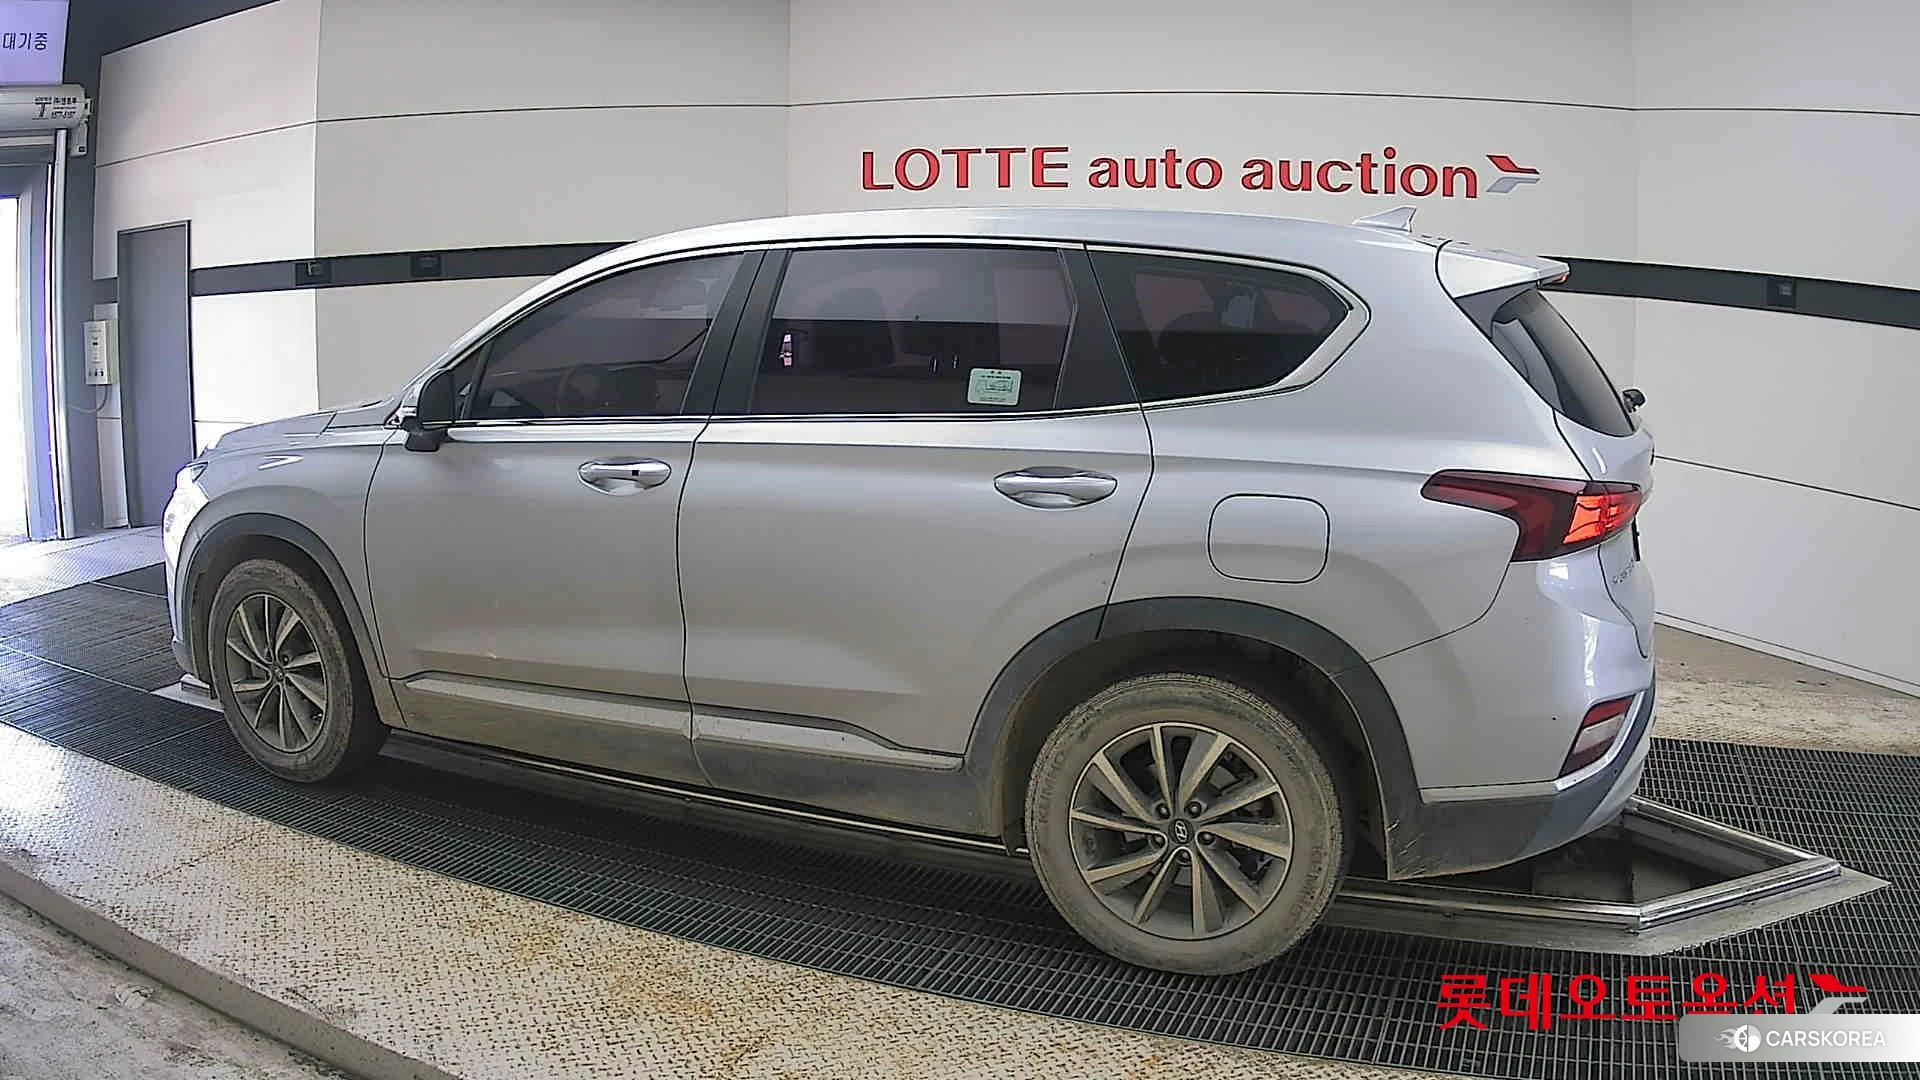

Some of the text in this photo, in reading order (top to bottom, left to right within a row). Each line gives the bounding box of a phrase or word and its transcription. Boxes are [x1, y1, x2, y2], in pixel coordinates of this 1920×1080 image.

[3, 32, 48, 51] 대기중
[862, 146, 1478, 198] LOTTE auto auction
